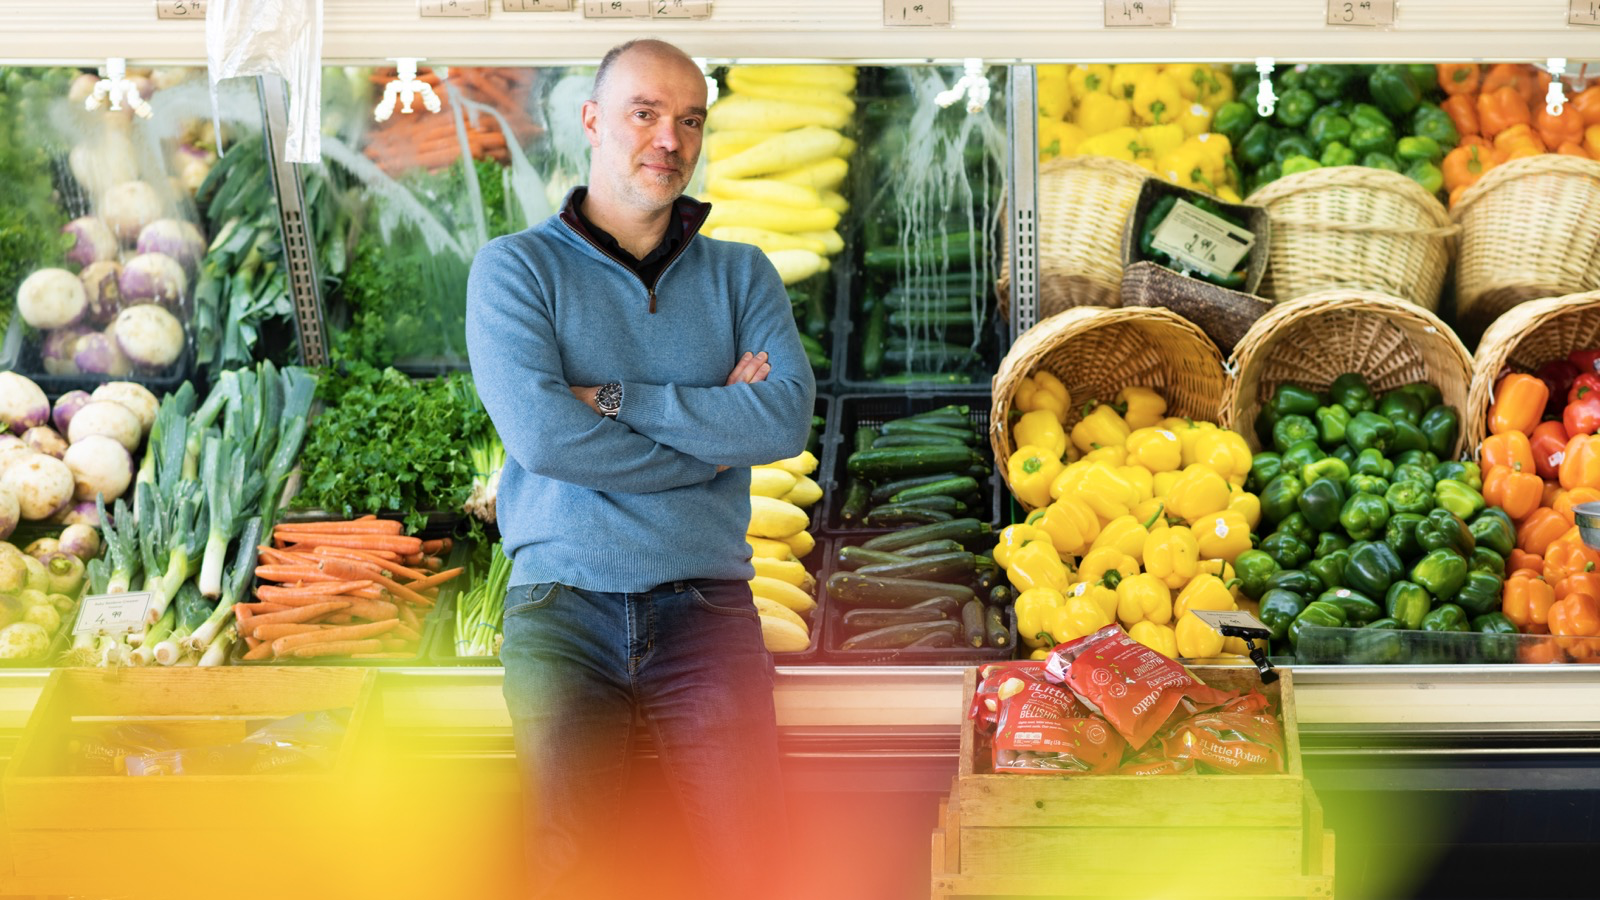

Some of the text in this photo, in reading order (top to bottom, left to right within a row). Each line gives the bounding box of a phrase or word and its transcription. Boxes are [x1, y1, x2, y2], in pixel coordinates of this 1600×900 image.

[1035, 683, 1072, 703] Little
[1202, 748, 1240, 767] Company
[1203, 740, 1232, 756] Little
[1234, 747, 1267, 764] Potato
